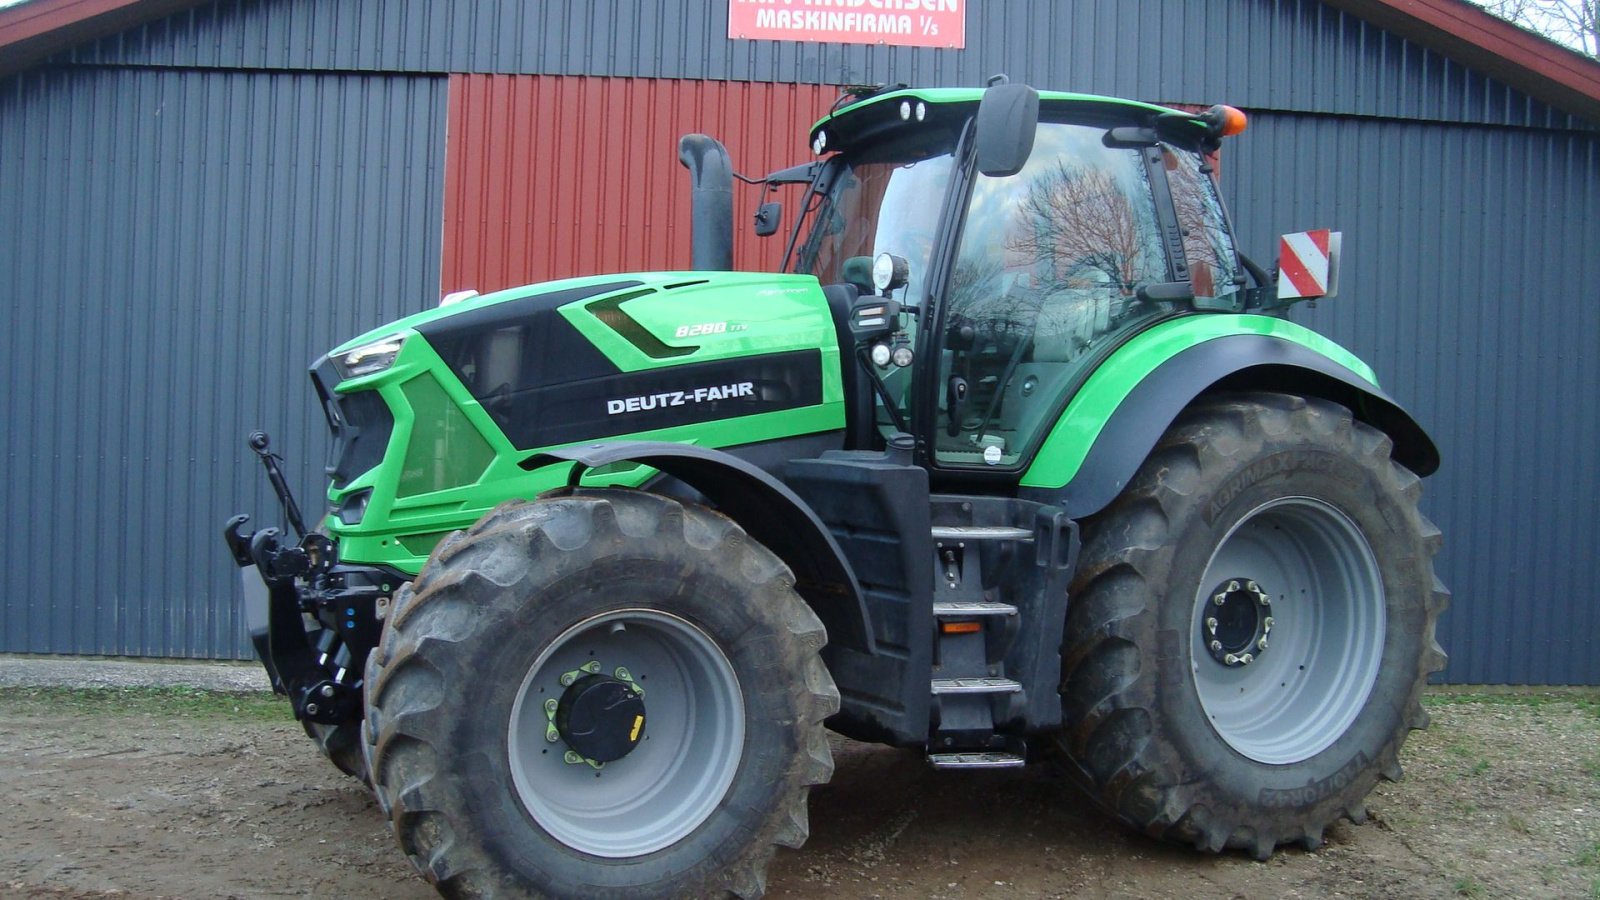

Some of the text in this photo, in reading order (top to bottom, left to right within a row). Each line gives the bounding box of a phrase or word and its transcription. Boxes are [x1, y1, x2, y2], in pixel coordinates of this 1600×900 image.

[756, 8, 912, 35] MASKINFIRMA
[675, 321, 727, 338] 8280
[607, 381, 754, 415] DEUTZ-FAHR
